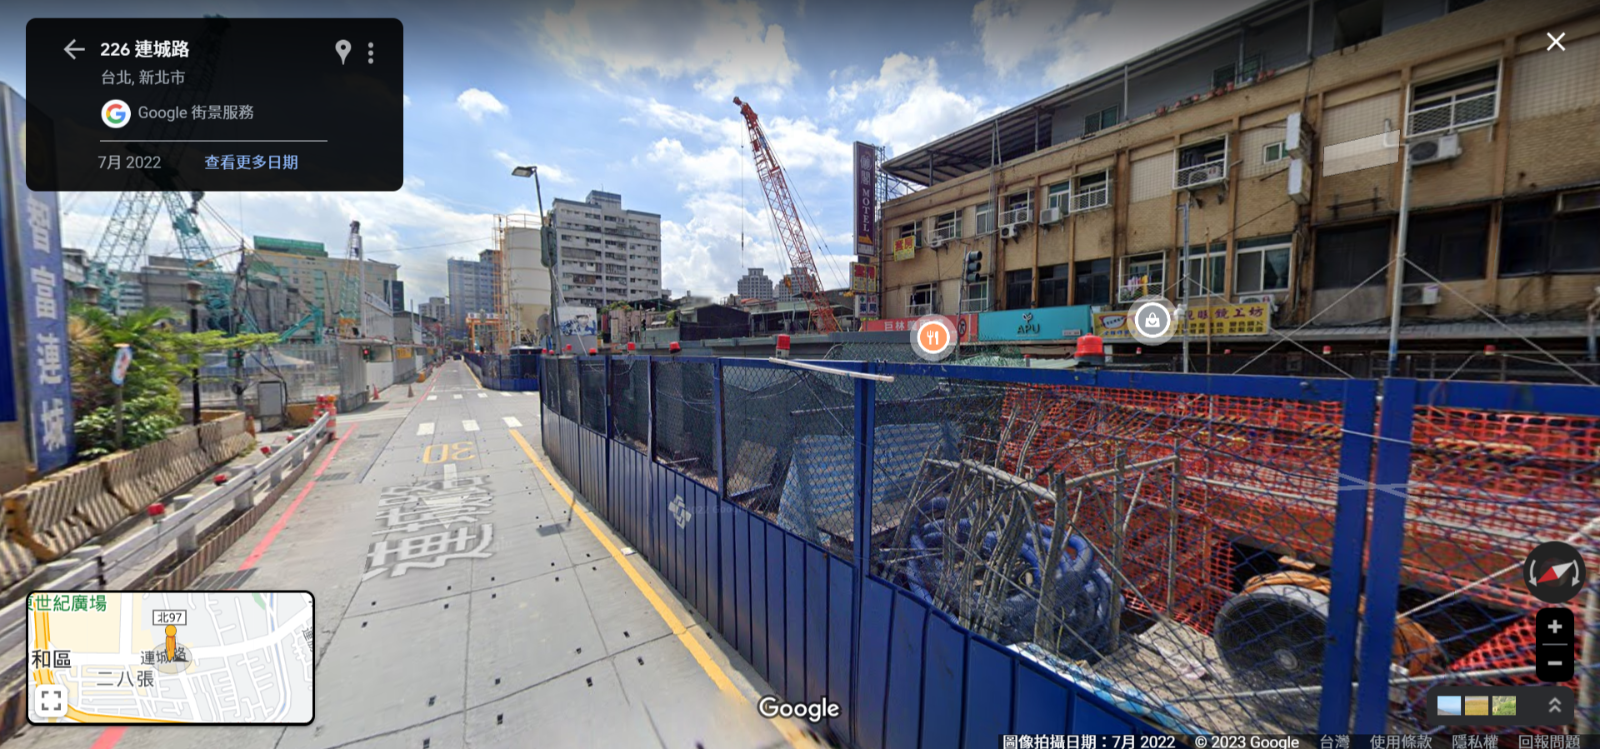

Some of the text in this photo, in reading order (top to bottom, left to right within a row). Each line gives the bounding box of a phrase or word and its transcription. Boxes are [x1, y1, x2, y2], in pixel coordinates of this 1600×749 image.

[862, 188, 871, 232] MOTEL
[28, 195, 67, 452] 智富連城
[1017, 324, 1041, 334] APU
